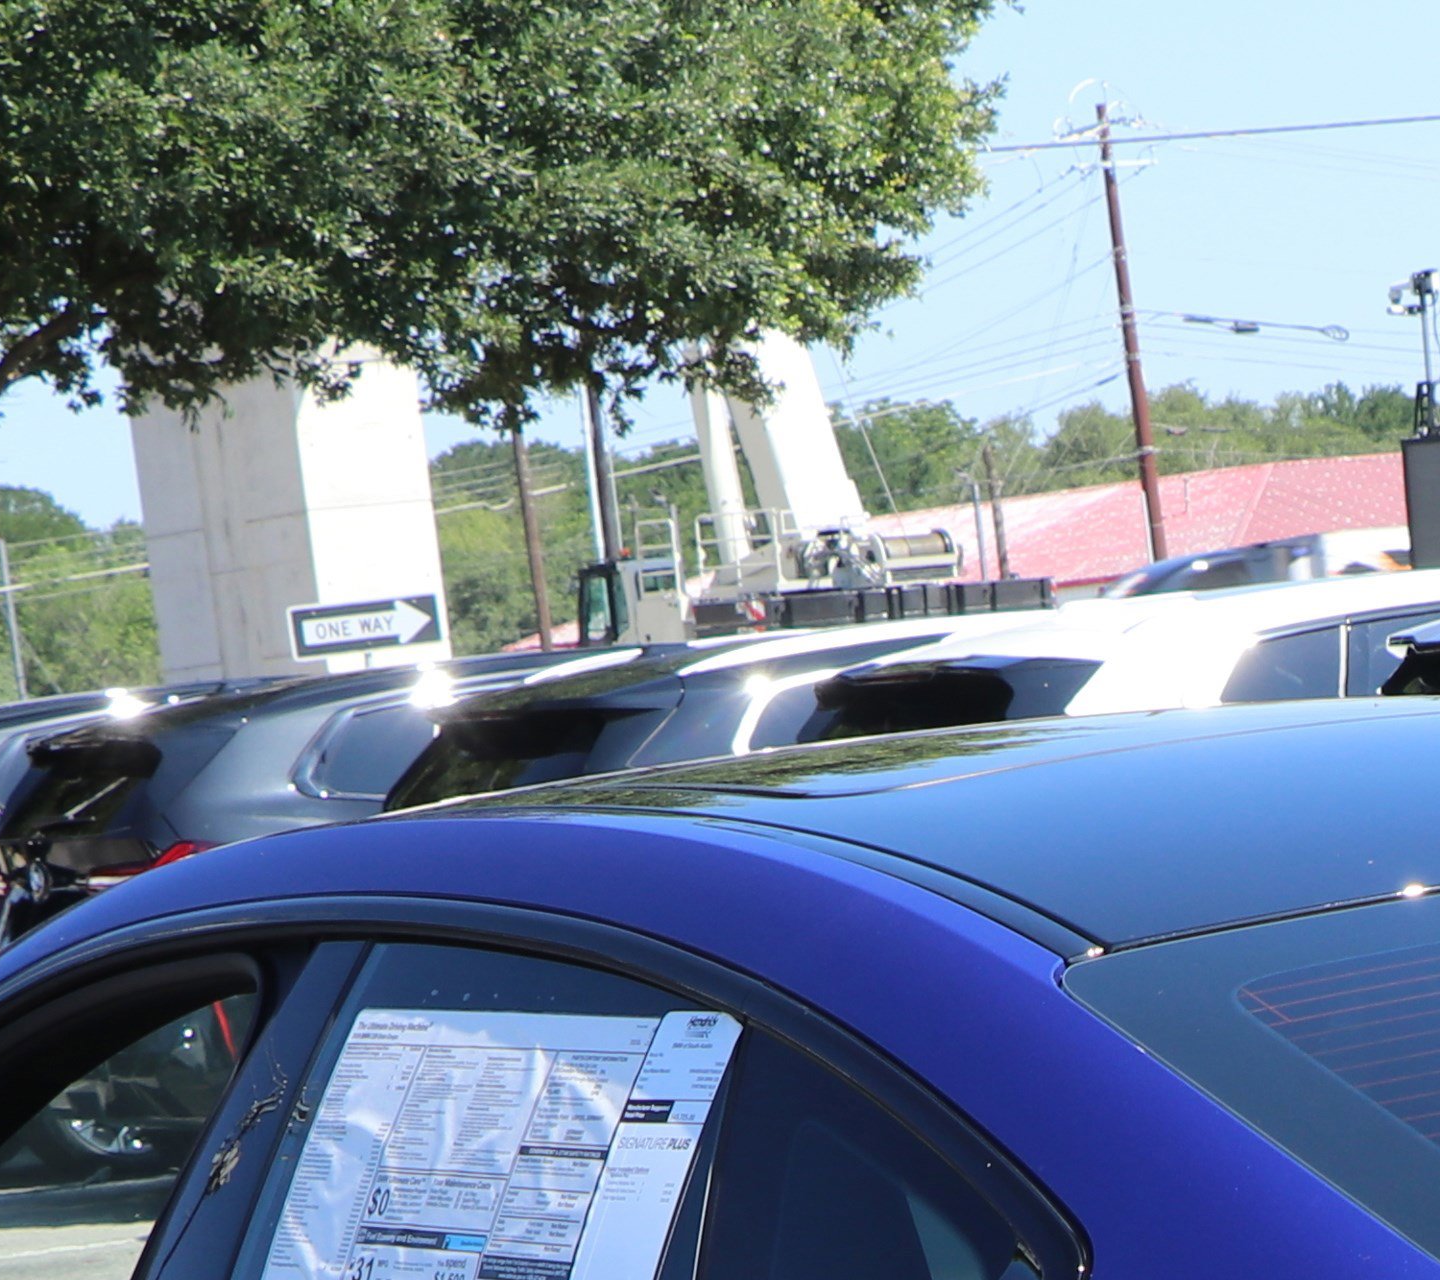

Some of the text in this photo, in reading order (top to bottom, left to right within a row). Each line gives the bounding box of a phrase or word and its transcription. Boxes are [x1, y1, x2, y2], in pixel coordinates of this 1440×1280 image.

[315, 615, 394, 639] ONE WAY
[617, 1137, 691, 1150] SIGNATURE PLUS
[368, 1187, 390, 1217] $0
